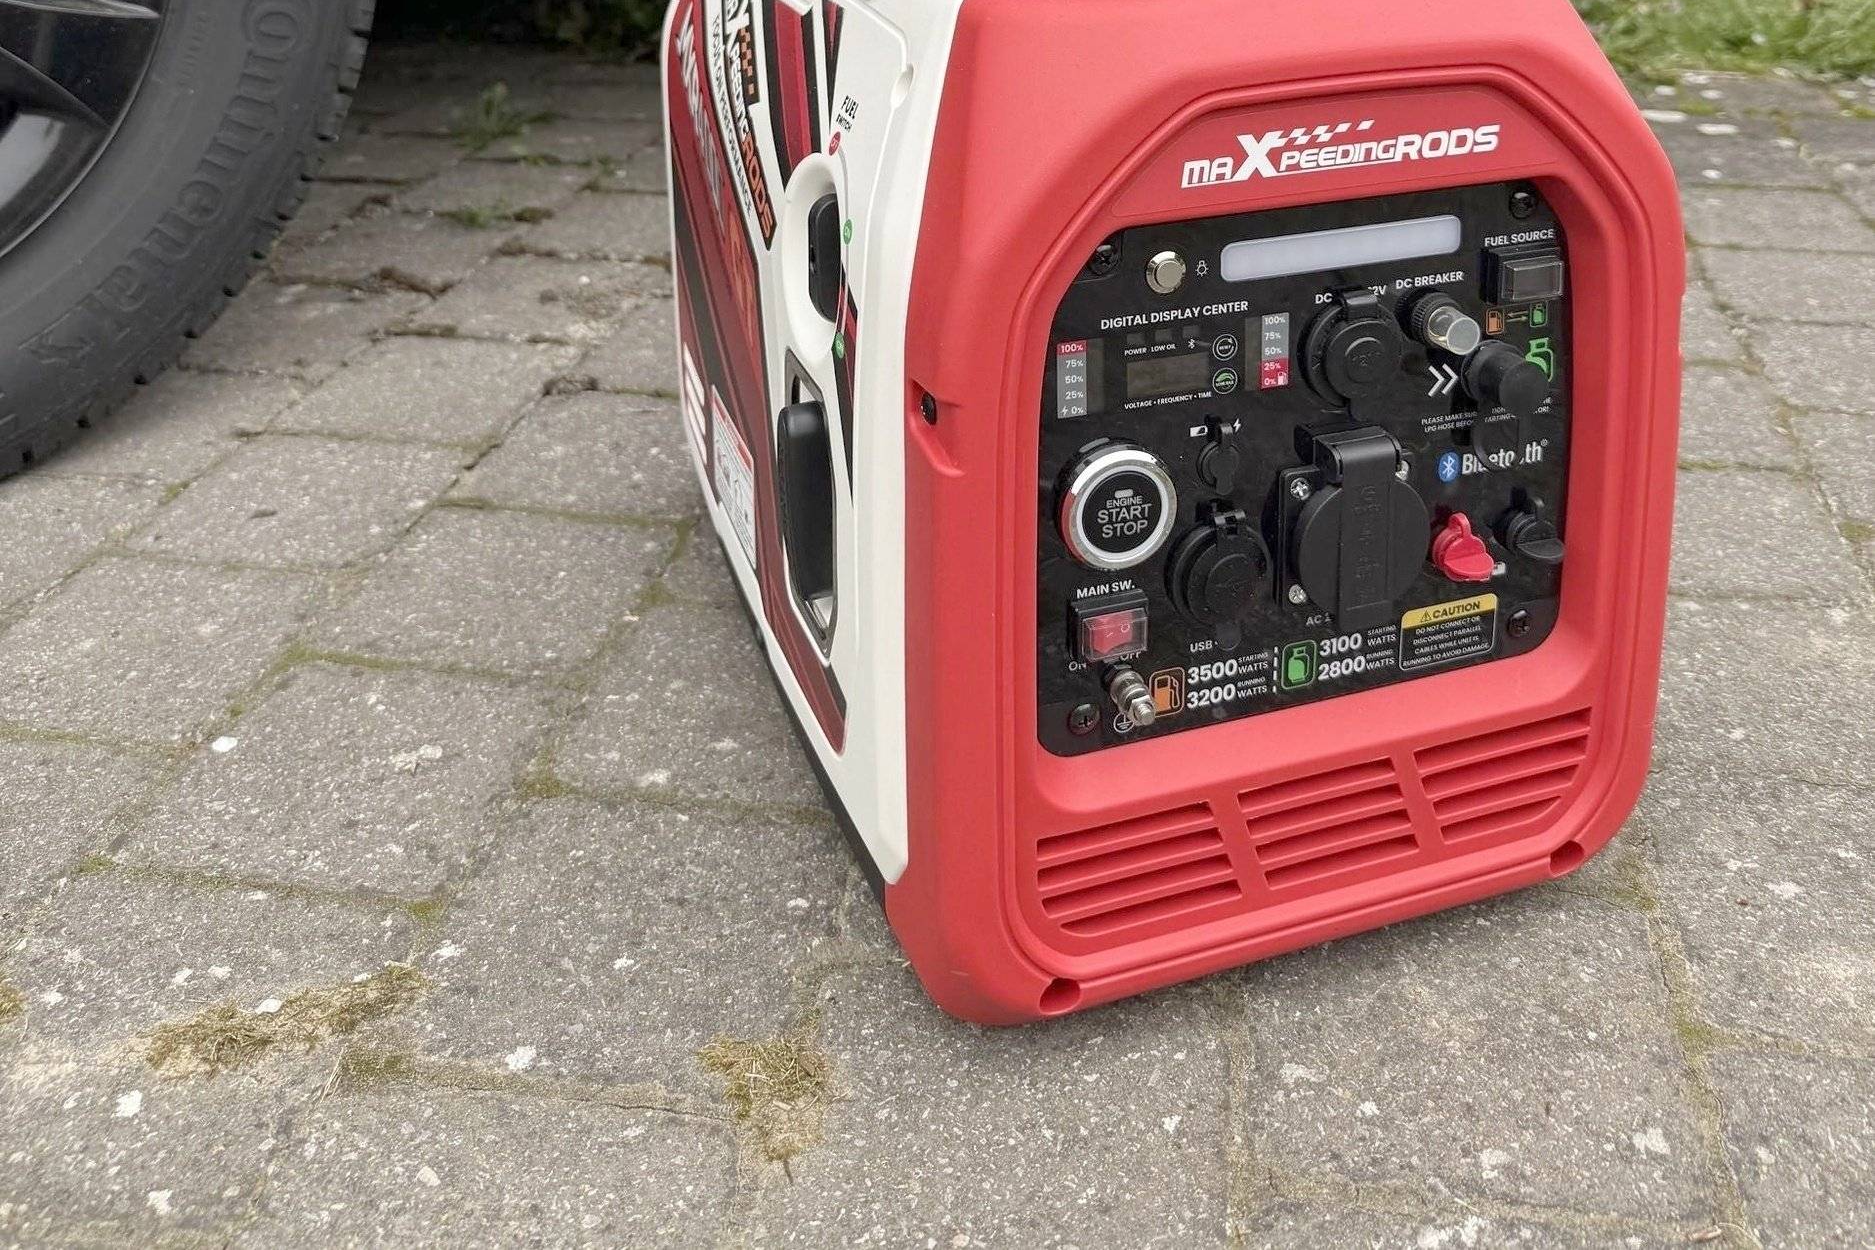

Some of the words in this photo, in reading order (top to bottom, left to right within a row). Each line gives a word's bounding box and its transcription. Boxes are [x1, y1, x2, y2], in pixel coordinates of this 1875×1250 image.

[841, 95, 859, 119] FUEL
[1485, 236, 1510, 247] FUEL
[1511, 229, 1554, 243] SOURCE
[1396, 278, 1413, 290] DC
[1415, 271, 1464, 286] BREAKER
[1315, 293, 1333, 303] DC
[1101, 314, 1149, 330] DIGITAL
[1150, 307, 1200, 323] DISPLAY
[1202, 301, 1249, 316] CENTER
[1264, 317, 1286, 325] 100%
[1264, 332, 1282, 340] 75%
[1060, 343, 1084, 353] 100%
[1124, 347, 1147, 356] POWER
[1165, 343, 1176, 351] OIL
[1264, 347, 1282, 355] 50%
[1065, 359, 1084, 368] 75%
[1264, 362, 1281, 370] 25%
[1065, 375, 1084, 383] 50%
[1264, 377, 1276, 385] 0%
[1065, 391, 1084, 399] 25%
[1124, 400, 1152, 409] VOLTAGE
[1157, 394, 1193, 405] FREQUENCY
[1071, 406, 1084, 414] 0%
[1422, 416, 1444, 425] PLEASE
[1445, 414, 1462, 422] MAKE
[1463, 411, 1477, 419] SUR
[1438, 422, 1455, 430] HOSE
[1106, 495, 1143, 508] ENGINE
[1097, 503, 1152, 524] START
[1102, 520, 1149, 538] STOP
[1077, 585, 1109, 599] MAIN
[1112, 579, 1135, 592] SW.
[1432, 600, 1481, 619] CAUTION
[1306, 614, 1322, 626] AC
[1367, 625, 1397, 636] STARTING
[1426, 624, 1439, 632] NOT
[1319, 632, 1362, 657] 3100
[1367, 634, 1397, 646] WATTS
[1190, 640, 1213, 653] USB
[1238, 652, 1268, 663] STARTING
[1366, 648, 1393, 660] RUNNING
[1366, 657, 1395, 670] WATTS
[1402, 655, 1432, 667] RUNNING
[1187, 658, 1238, 684] 3500
[1238, 661, 1269, 674] WATTS
[1318, 655, 1366, 681] 2800
[1237, 676, 1266, 687] RUNNING
[1186, 683, 1236, 709] 3200
[1237, 685, 1268, 699] WATTS
